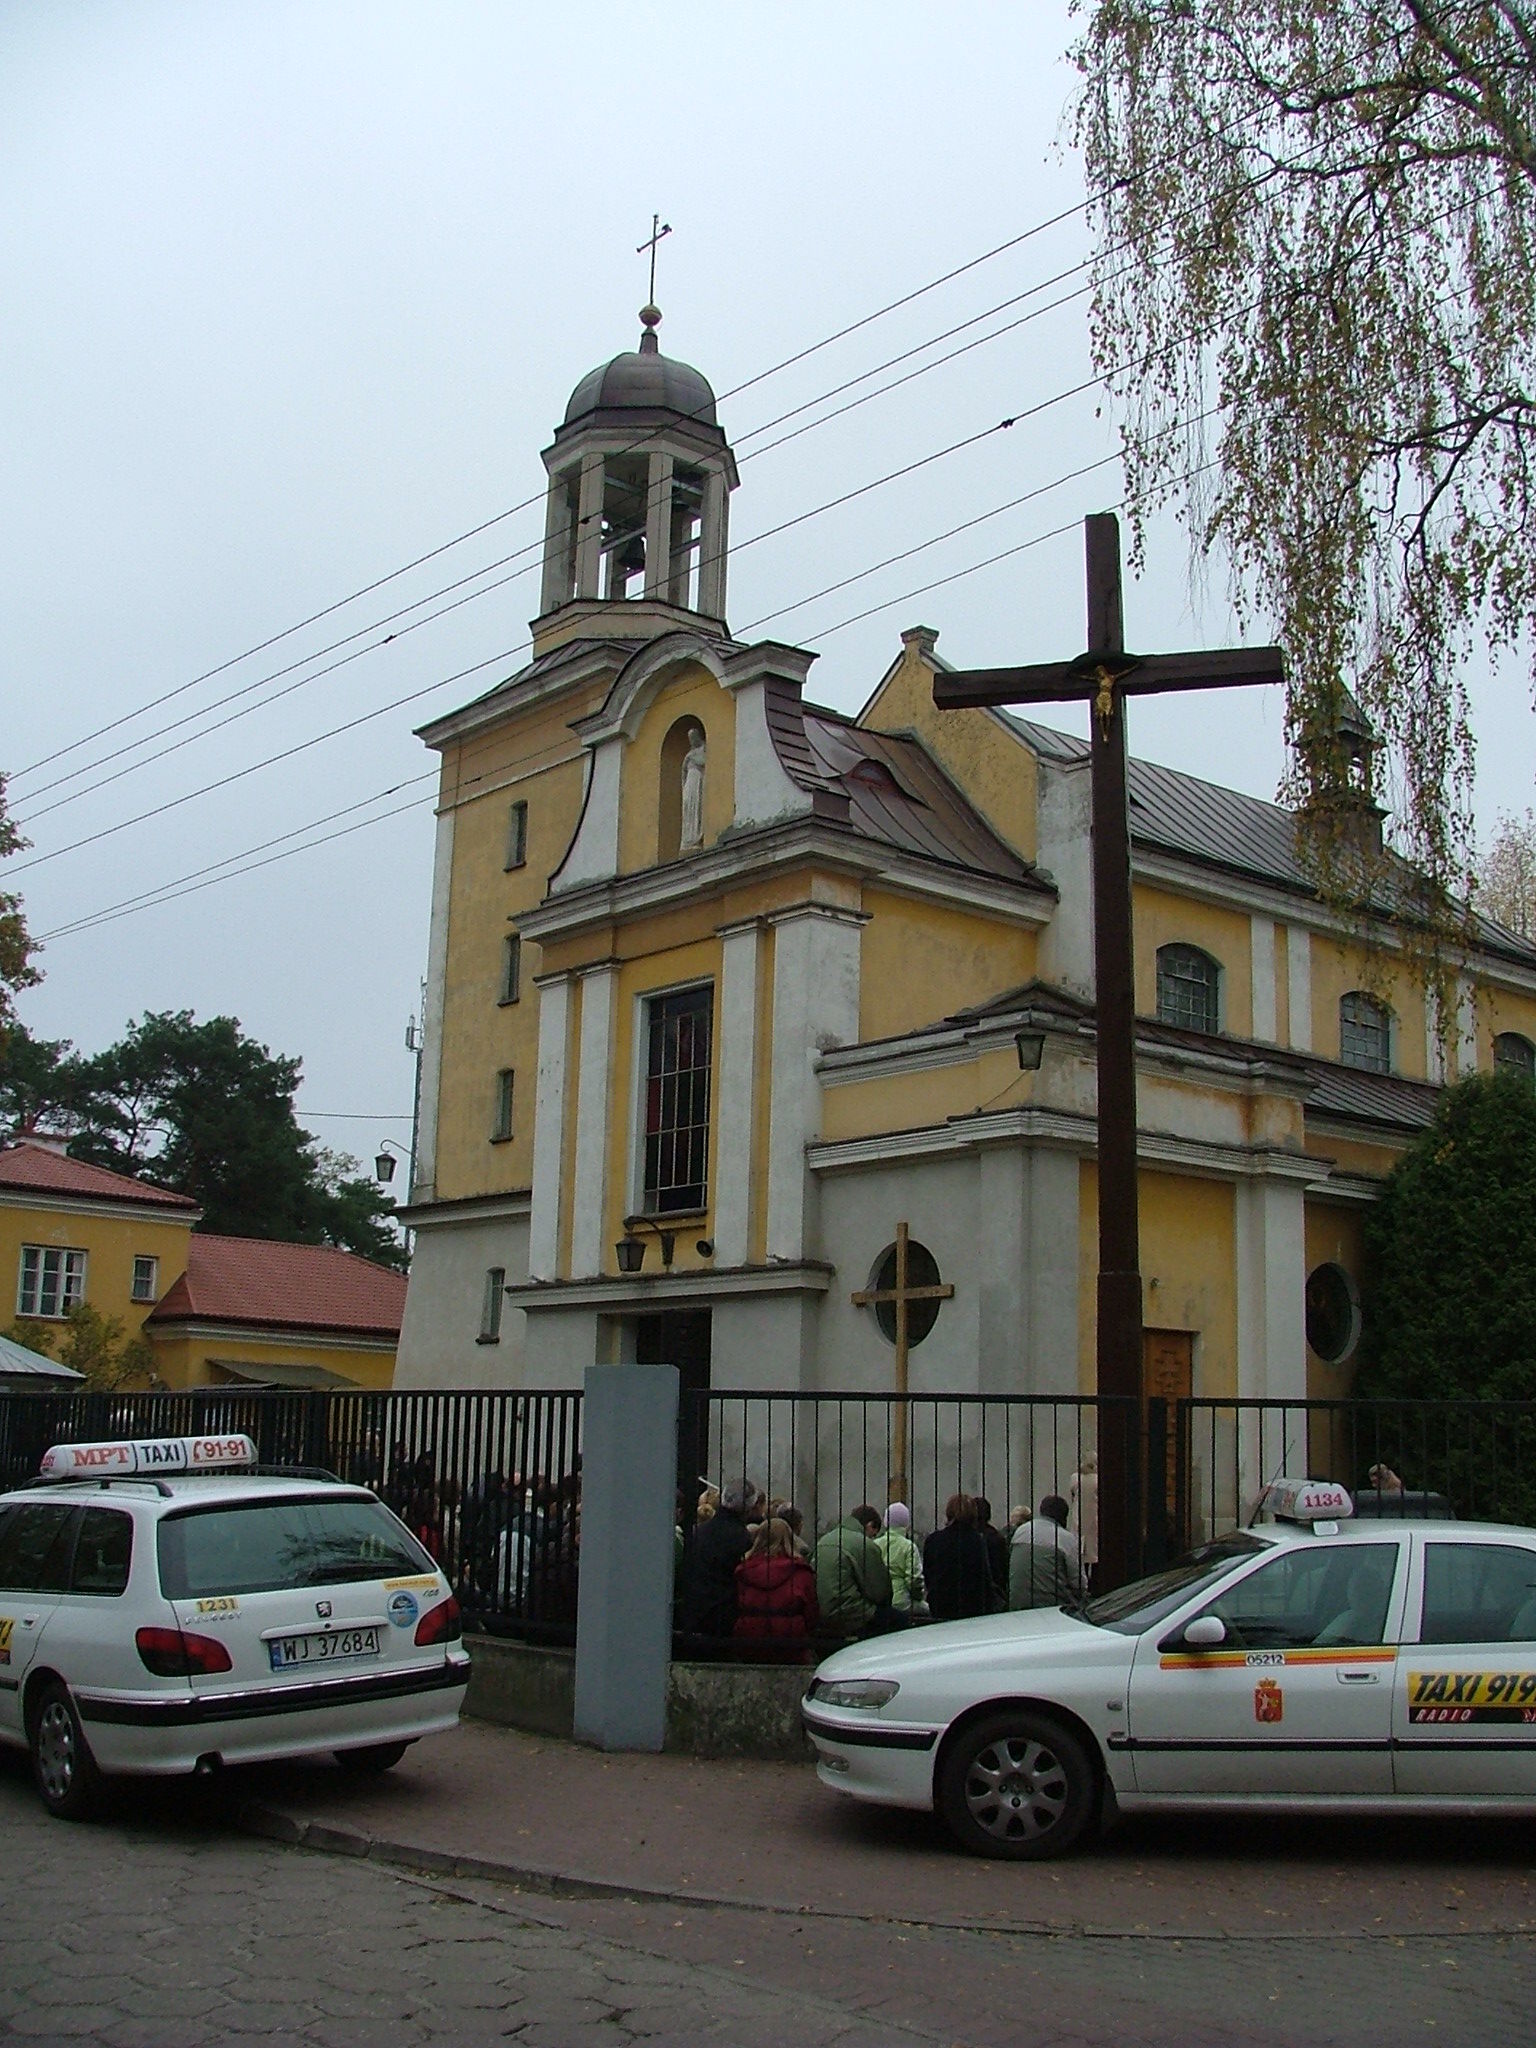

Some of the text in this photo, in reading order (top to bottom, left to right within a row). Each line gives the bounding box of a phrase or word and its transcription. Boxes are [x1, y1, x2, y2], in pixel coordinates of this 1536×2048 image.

[72, 1445, 129, 1467] MPT
[140, 1443, 181, 1464] TAXI
[203, 1439, 248, 1458] 91-91
[1304, 1493, 1344, 1508] 1134
[196, 1598, 236, 1613] 1231
[283, 1630, 375, 1661] WJ 37684
[1247, 1654, 1284, 1665] 05212
[1413, 1674, 1536, 1702] TAXI 919
[1415, 1708, 1472, 1721] RADIO
